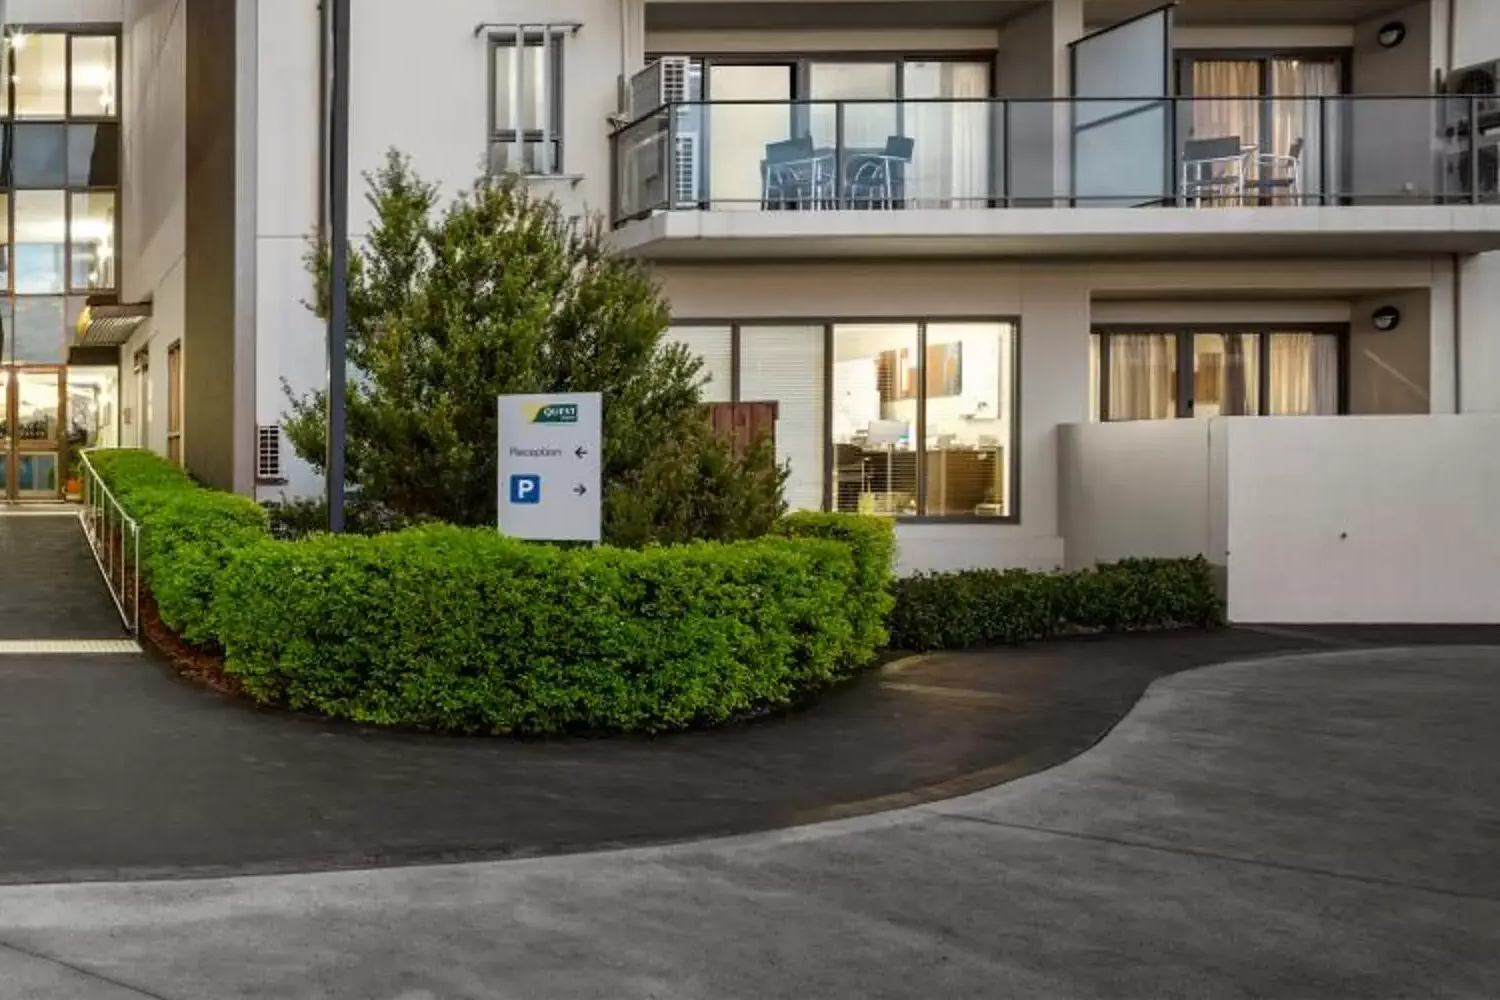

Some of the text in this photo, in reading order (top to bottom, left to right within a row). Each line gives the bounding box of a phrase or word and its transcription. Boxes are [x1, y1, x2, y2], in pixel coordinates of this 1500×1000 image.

[543, 407, 576, 417] QUEST
[509, 446, 562, 459] Reception
[518, 479, 534, 499] P
